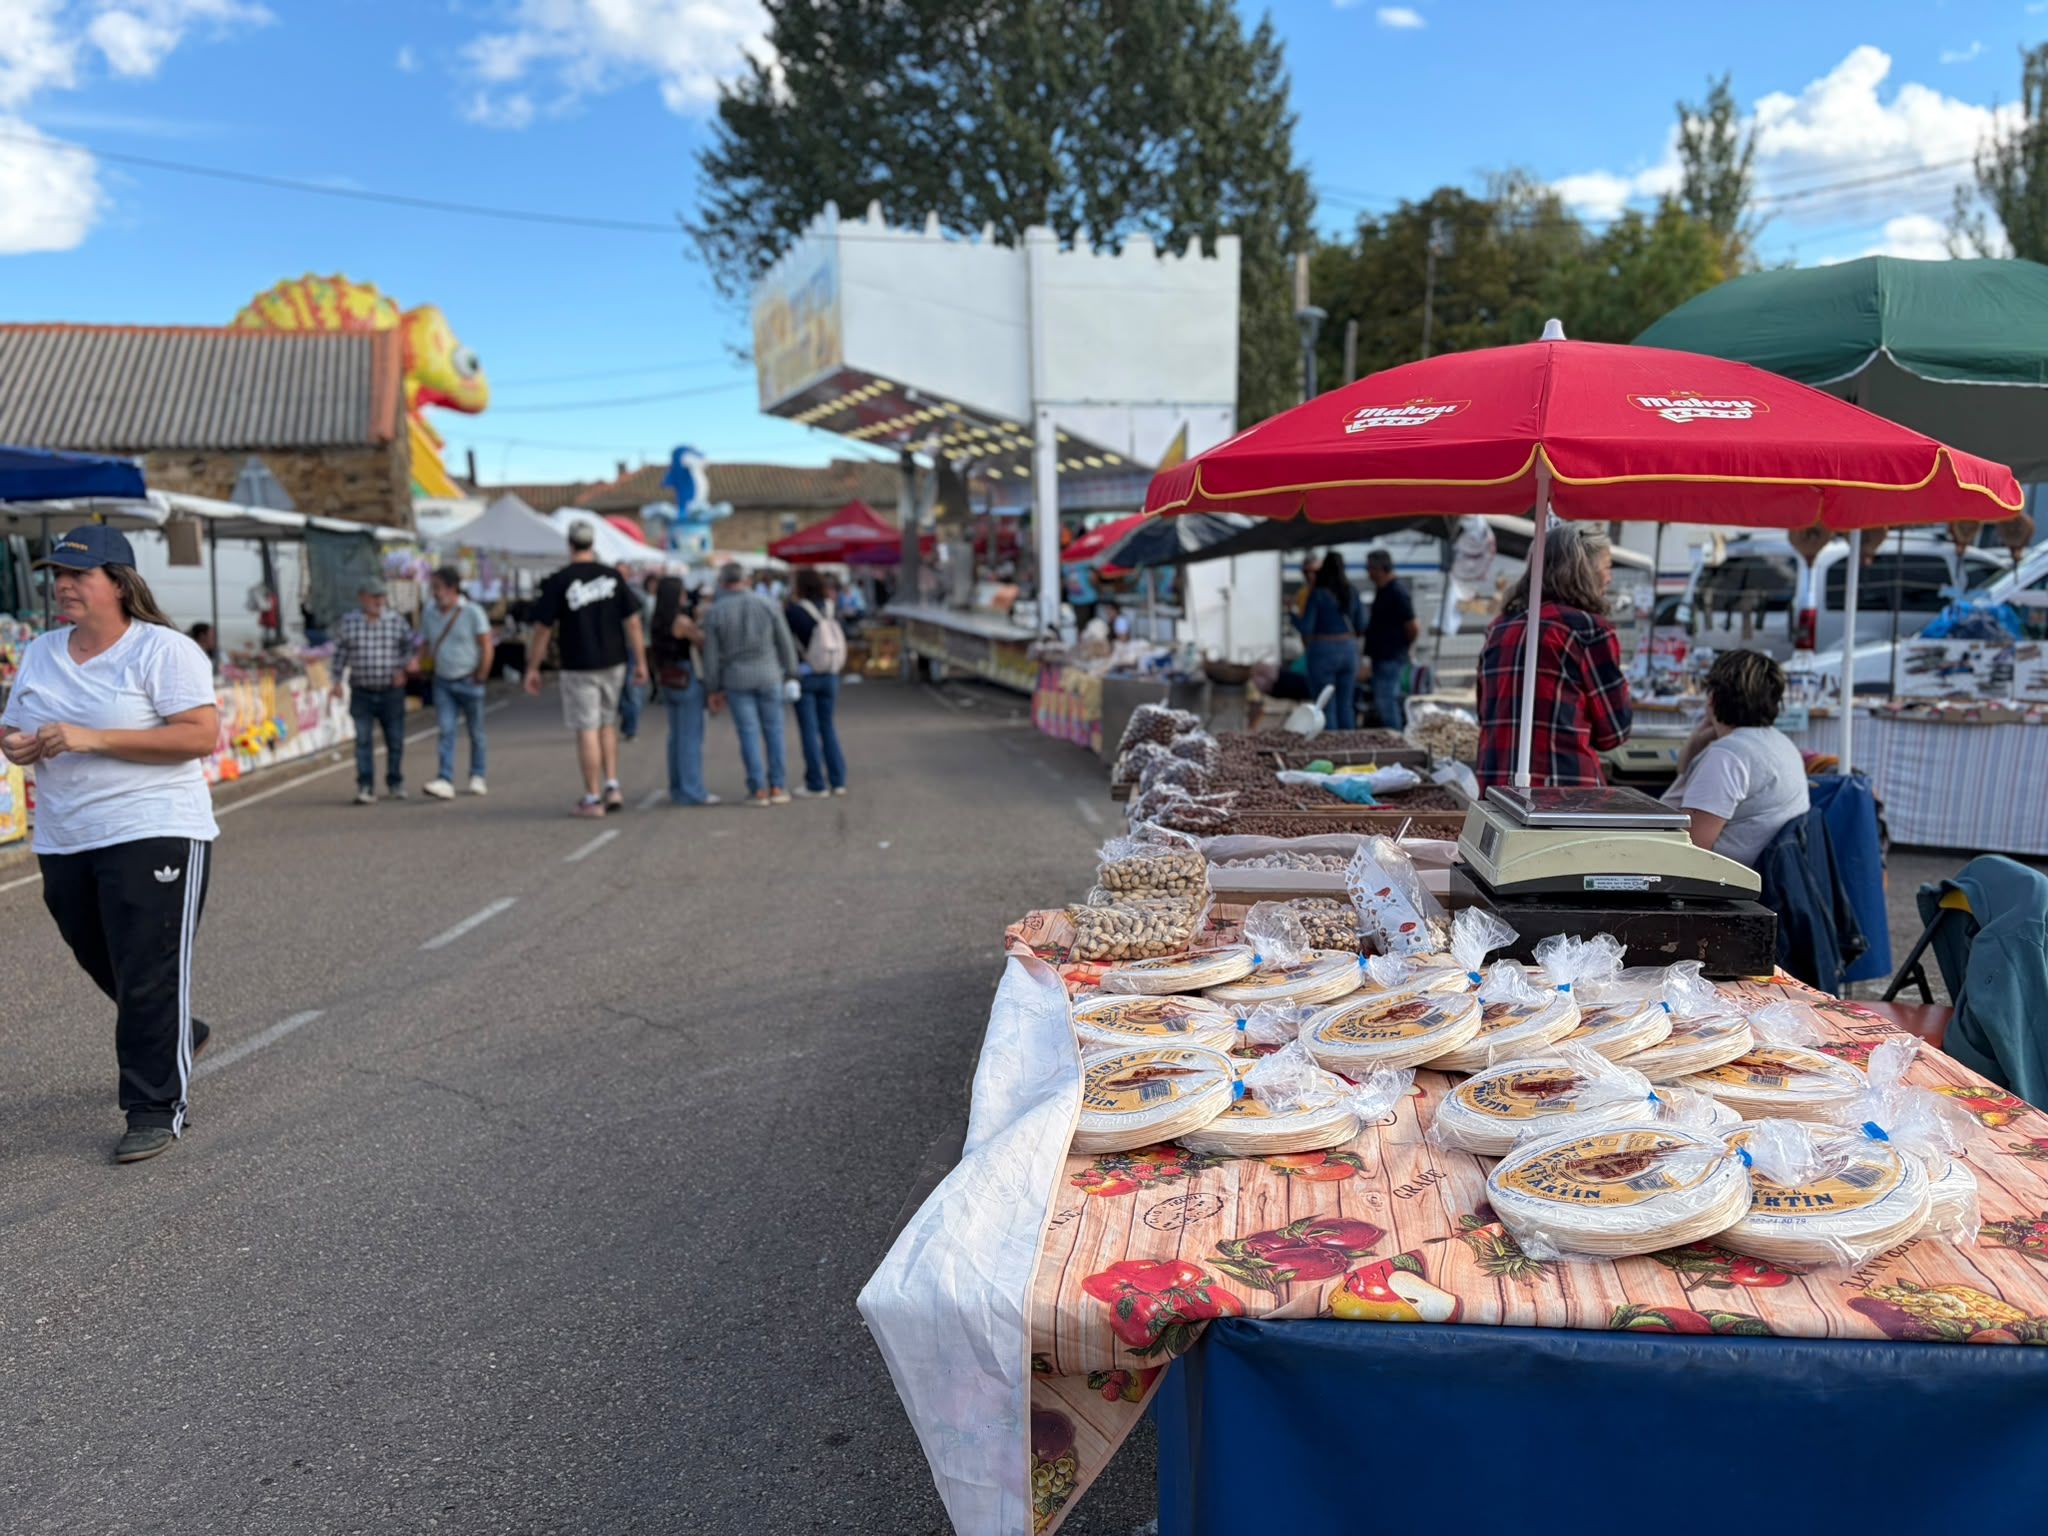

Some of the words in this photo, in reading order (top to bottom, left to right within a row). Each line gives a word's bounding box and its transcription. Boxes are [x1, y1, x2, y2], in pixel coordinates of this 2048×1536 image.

[1636, 397, 1757, 409] Mahou
[1354, 405, 1457, 418] Mahou
[1393, 1169, 1447, 1199] GRAPE
